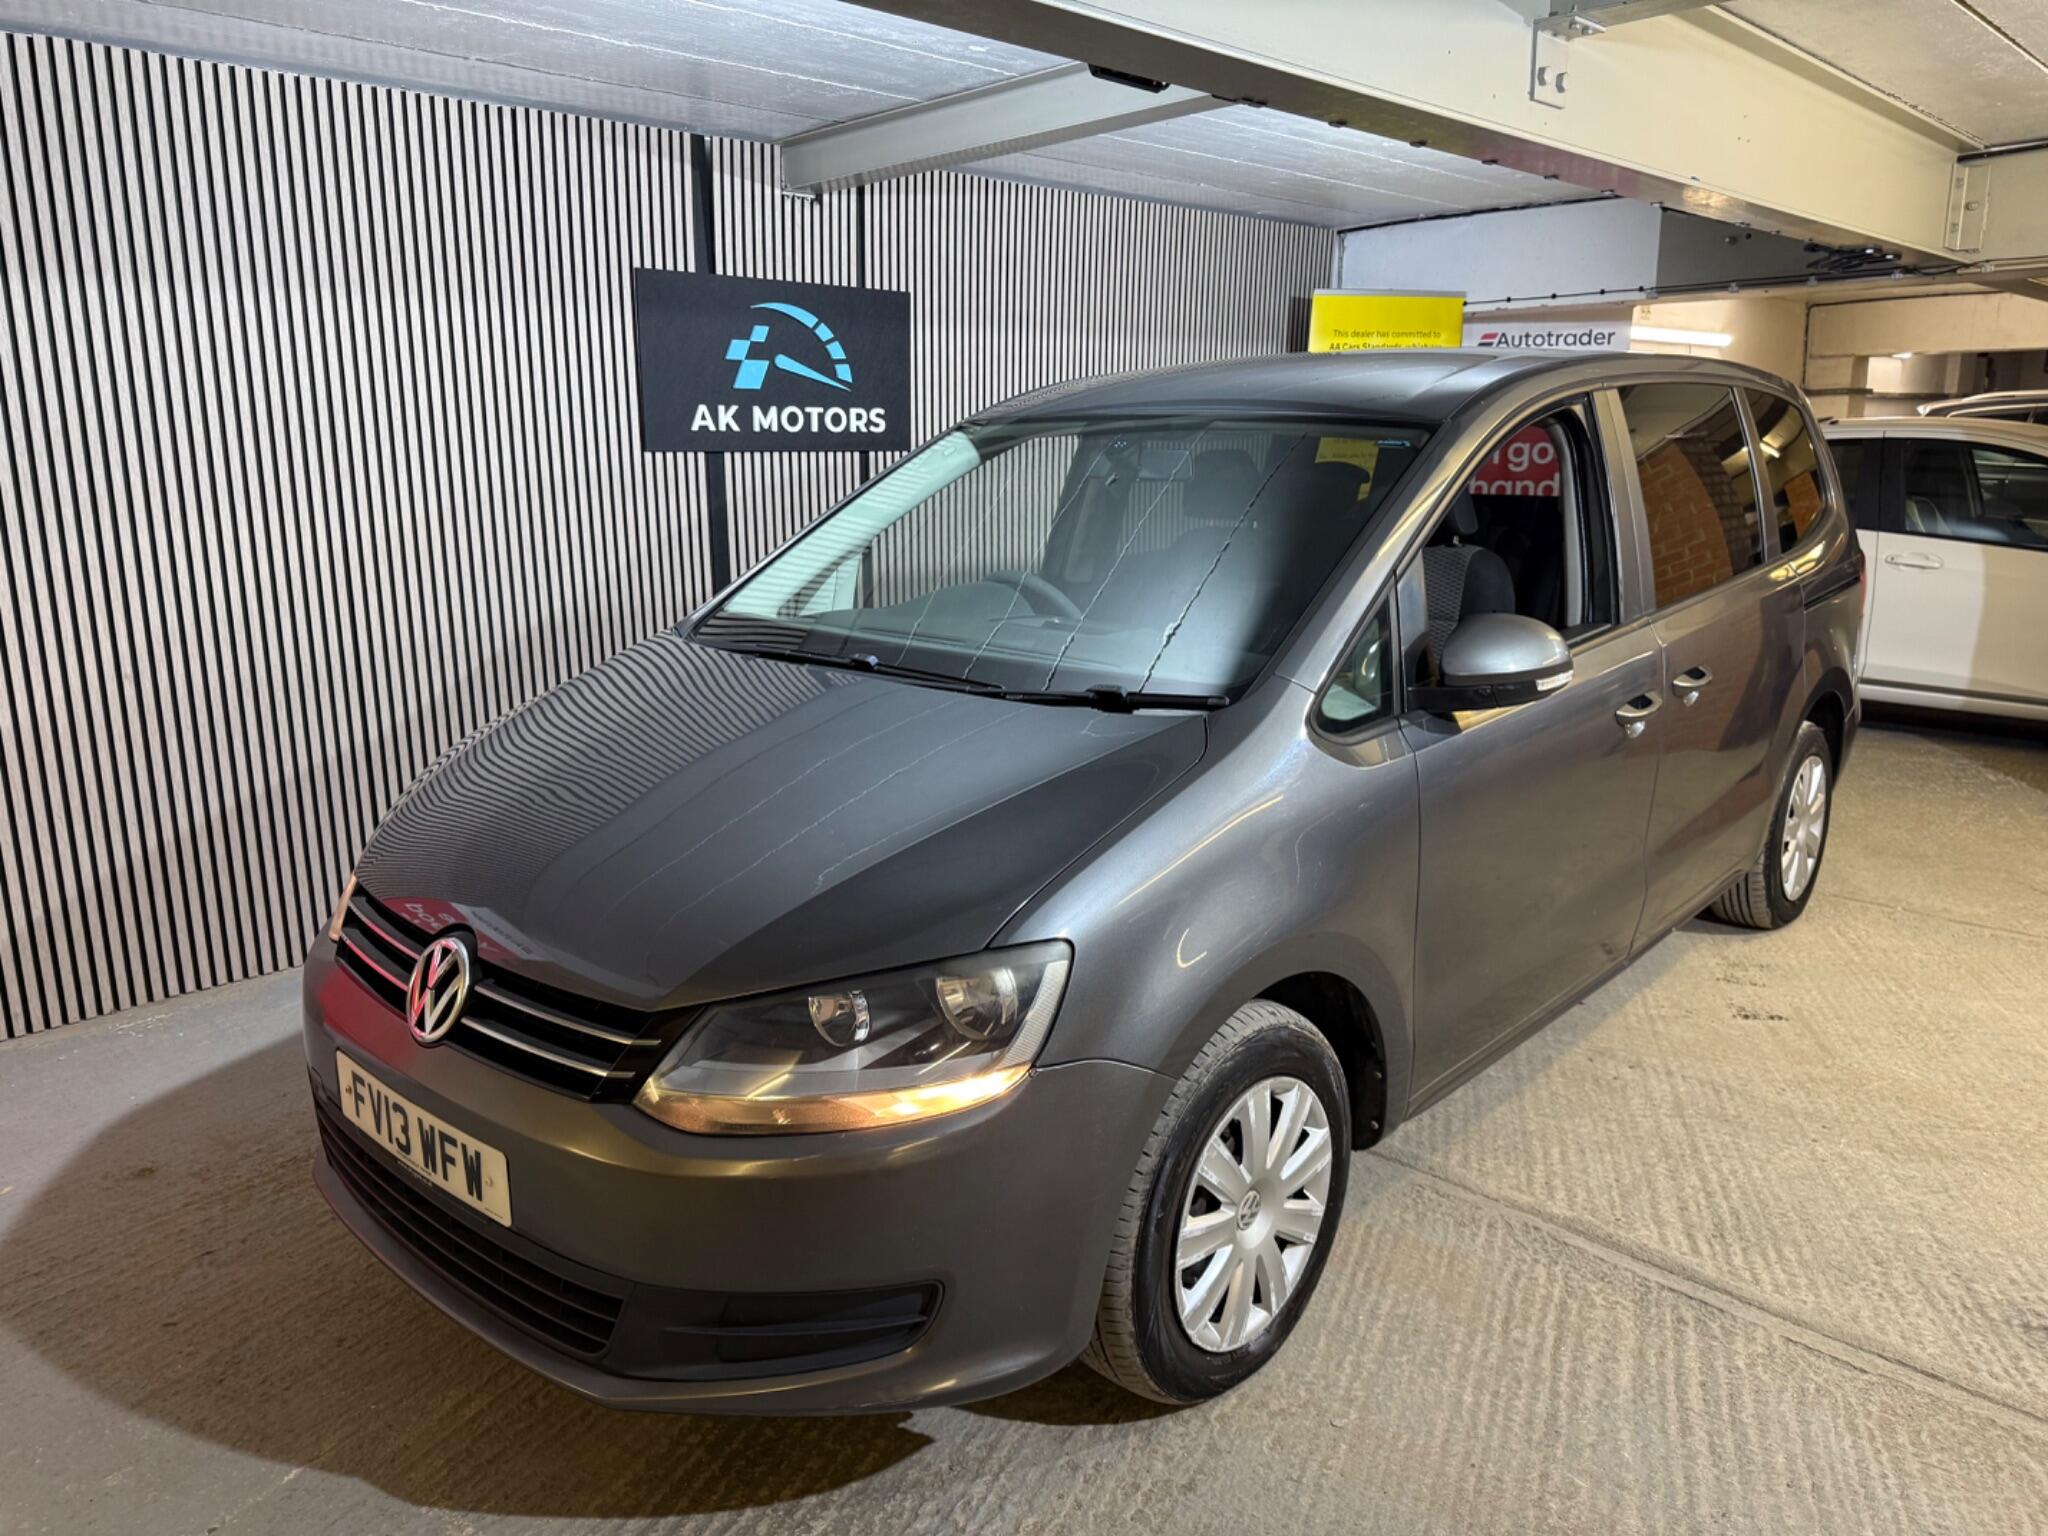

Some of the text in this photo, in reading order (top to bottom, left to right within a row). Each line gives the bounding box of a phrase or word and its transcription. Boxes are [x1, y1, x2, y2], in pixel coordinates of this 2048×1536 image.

[1333, 329, 1441, 339] This dealer has committed to
[1495, 329, 1616, 348] Autotrader
[691, 403, 887, 433] AK MOTORS
[1507, 442, 1555, 473] go
[351, 1070, 484, 1202] FV13 WFW
